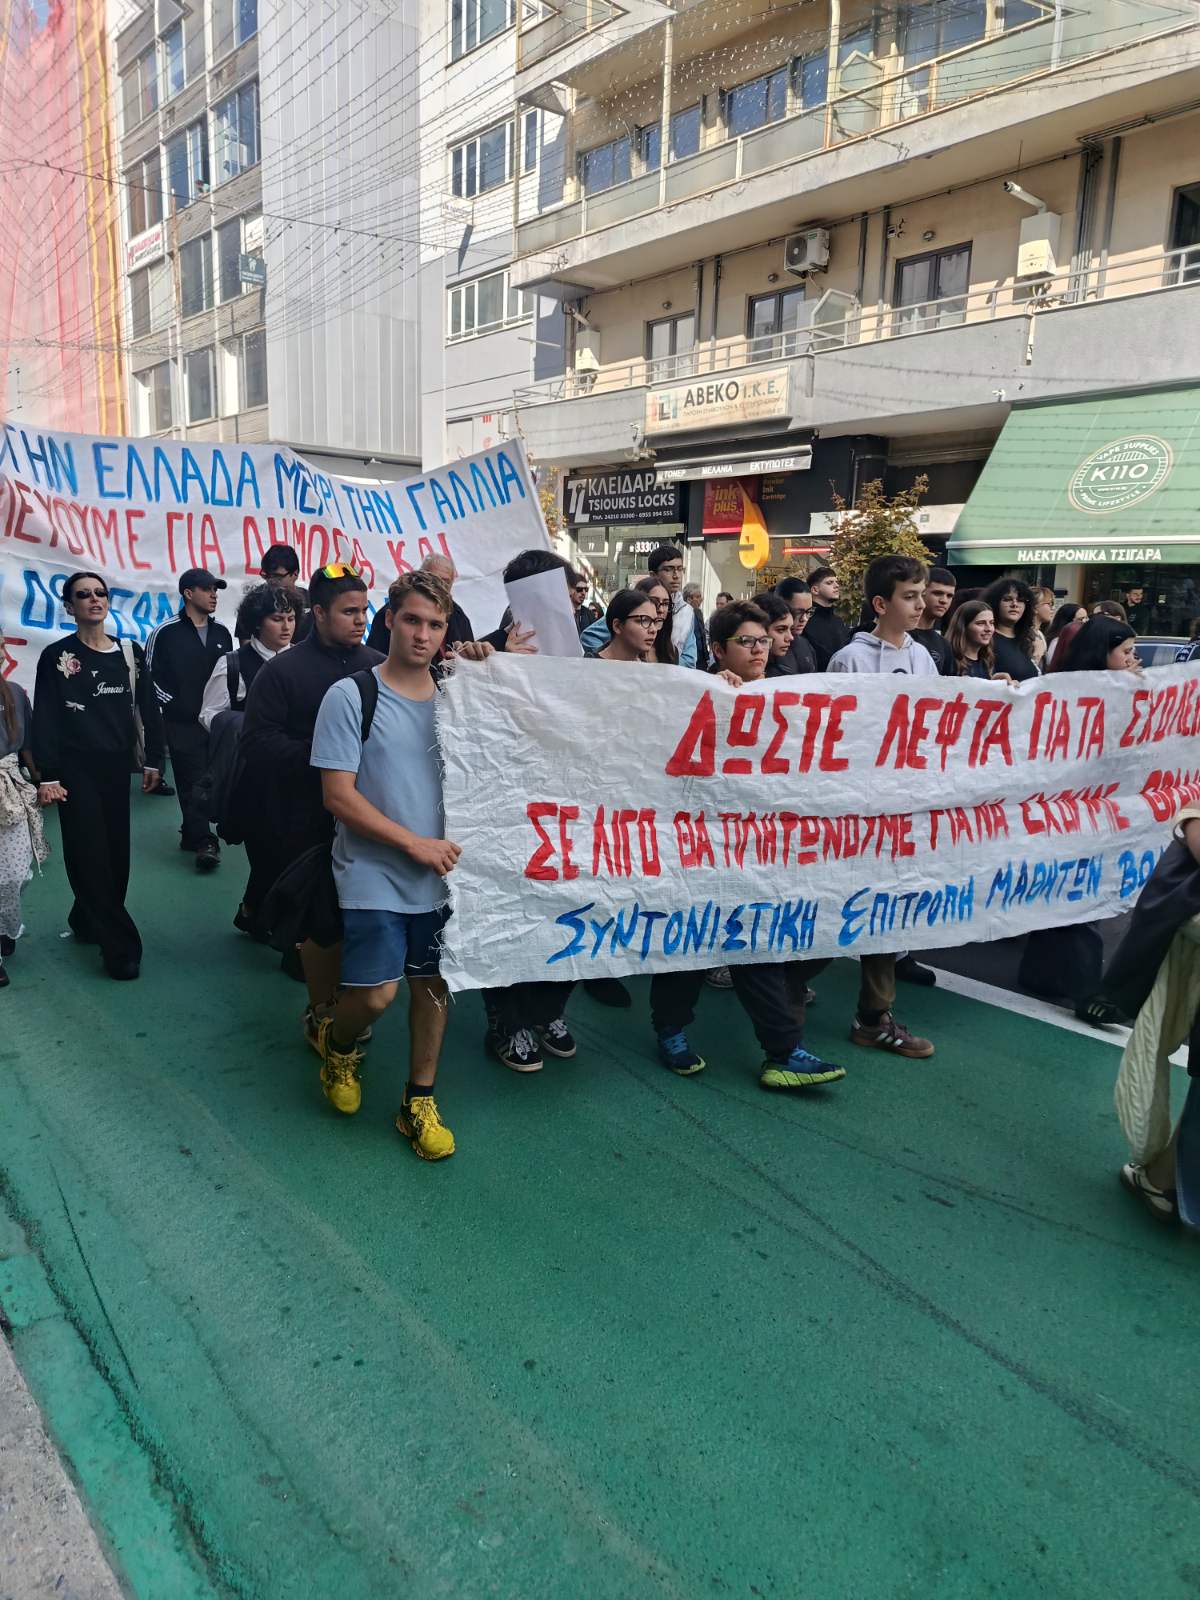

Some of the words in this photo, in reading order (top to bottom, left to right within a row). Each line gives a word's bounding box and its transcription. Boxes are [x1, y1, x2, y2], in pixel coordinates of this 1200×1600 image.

[93, 442, 260, 508] ΕΛΛΑΔΑ
[274, 452, 345, 528] ΜΕΧΡΙ
[341, 484, 402, 535] ΤΗΝ
[406, 451, 526, 530] ΓΑΛΛΙΑ
[589, 497, 636, 511] TSIOUKIS
[638, 493, 675, 508] LOCKS
[167, 512, 225, 577] ΓΙΑ
[243, 516, 375, 589] ΔΗΜΟΣΑ
[1017, 549, 1106, 561] ΗΛΕΚΤΡΟΝΙΚΑ
[1110, 549, 1162, 561] ΤΣΙΓΑΡΑ
[92, 682, 124, 696] Jamais
[665, 689, 858, 777] ΔΩΣΤΕ
[875, 692, 1013, 772] ΛΕΦΤΑ
[524, 802, 580, 881] ΣΕ
[592, 804, 662, 879] ΛΙΓΟ
[673, 811, 716, 870] ΘΑ
[546, 897, 819, 964] ΣΥΝΤΟΝΙΣΤΙΚΗ
[838, 875, 974, 946] ΕΠΙΤΡΟΠΗ
[985, 853, 1103, 910] ΜΑΘΗΤΩΝ
[1119, 846, 1166, 898] ΒΟ
